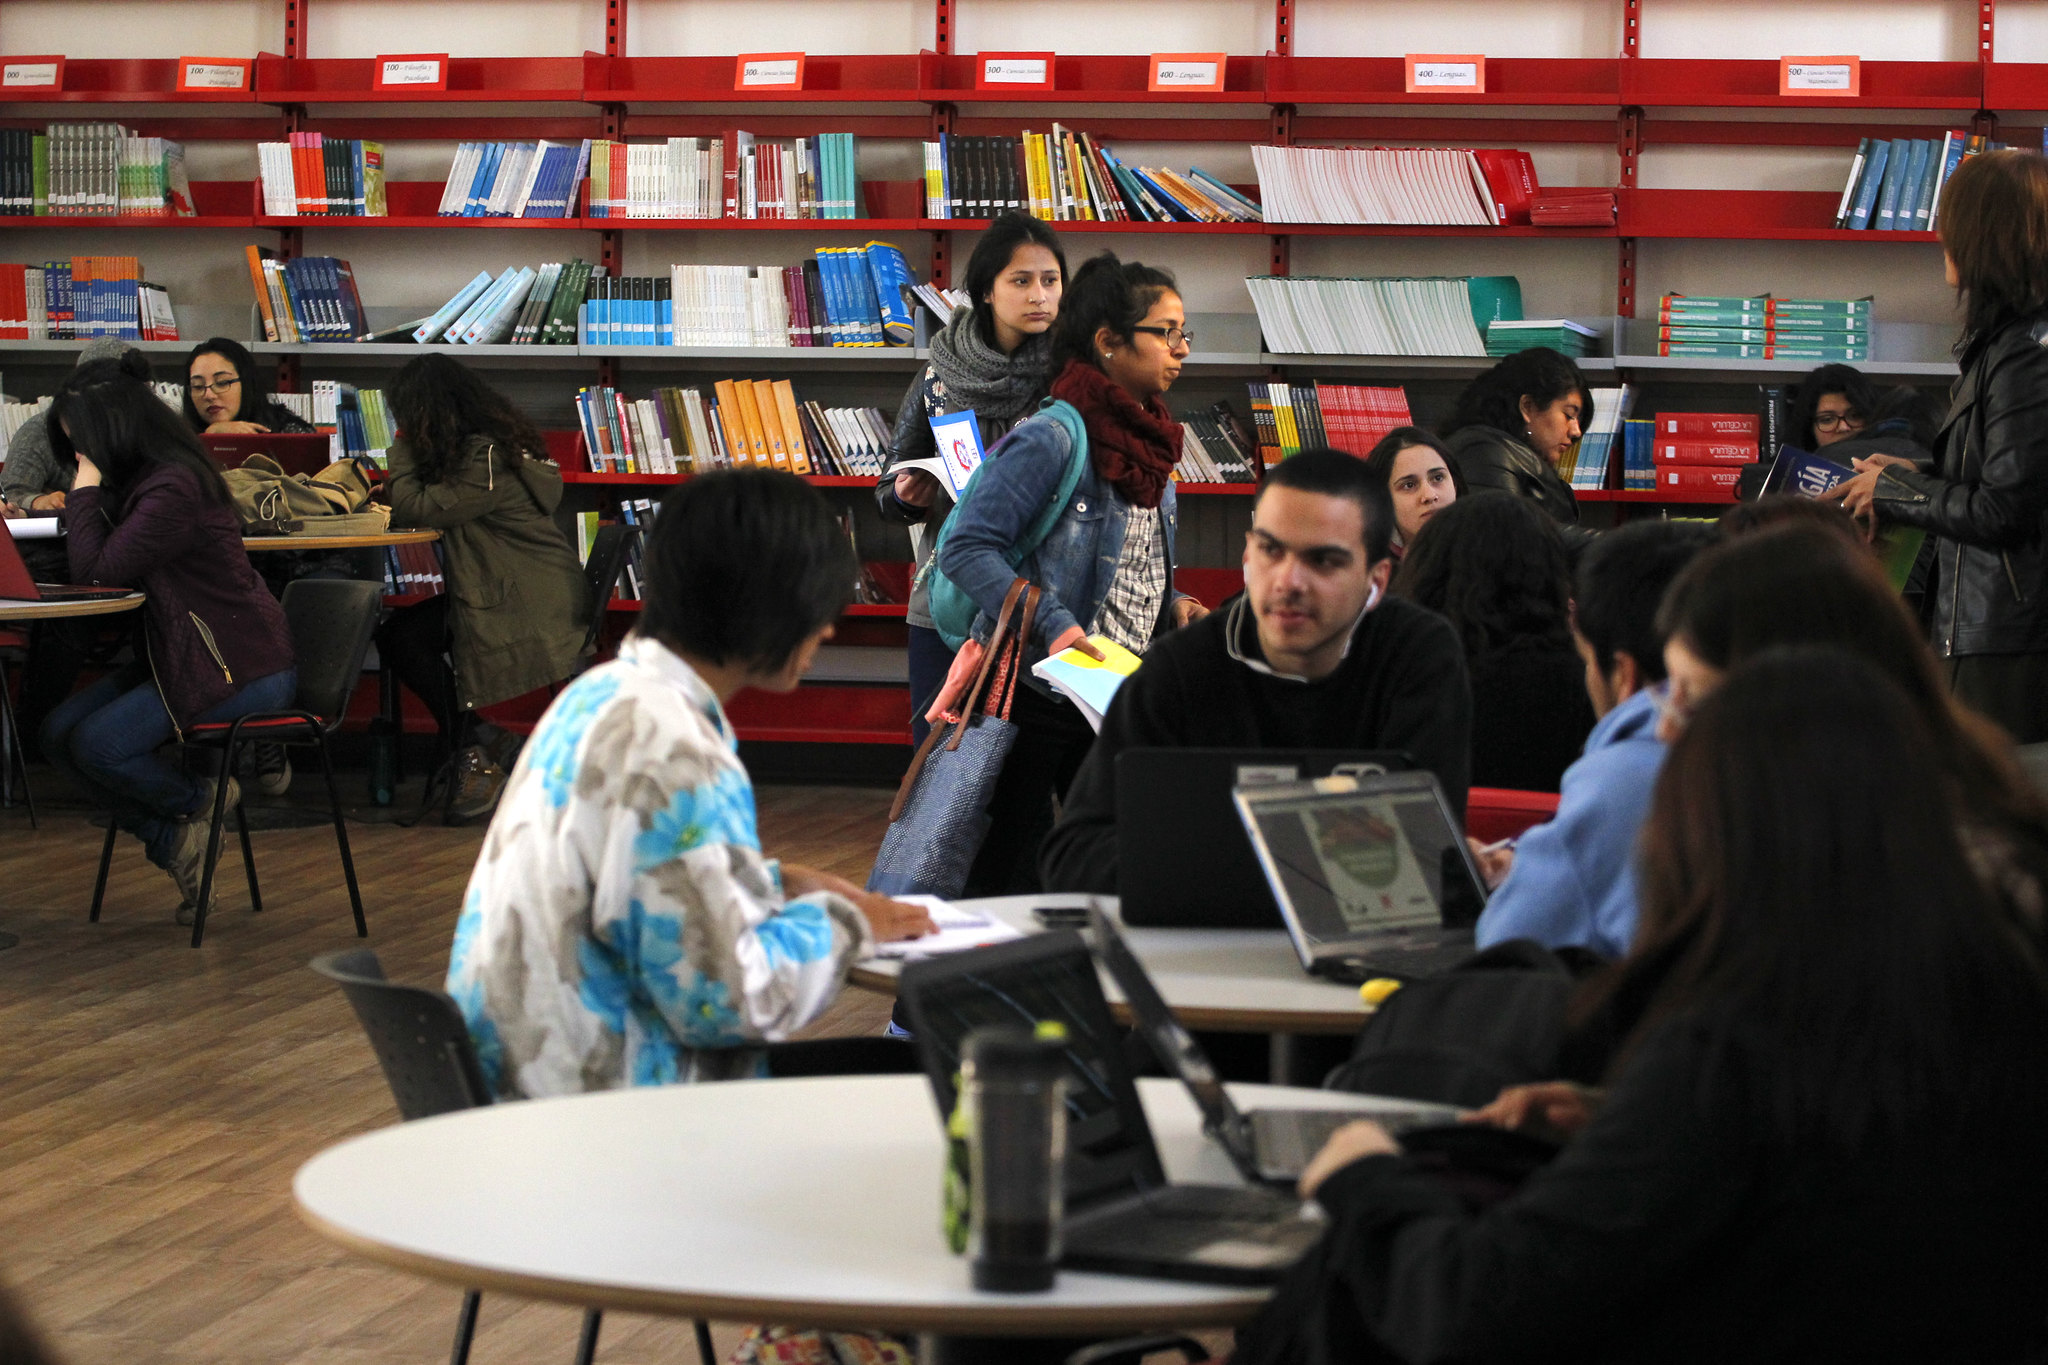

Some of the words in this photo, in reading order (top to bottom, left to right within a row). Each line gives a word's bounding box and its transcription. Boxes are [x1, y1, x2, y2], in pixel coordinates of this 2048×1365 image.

[190, 67, 204, 75] 100
[987, 66, 1001, 74] 300
[1418, 70, 1433, 78] 400
[7, 71, 20, 79] 000
[1742, 421, 1752, 429] LA
[1769, 434, 1776, 442] DE
[1739, 447, 1750, 455] LA
